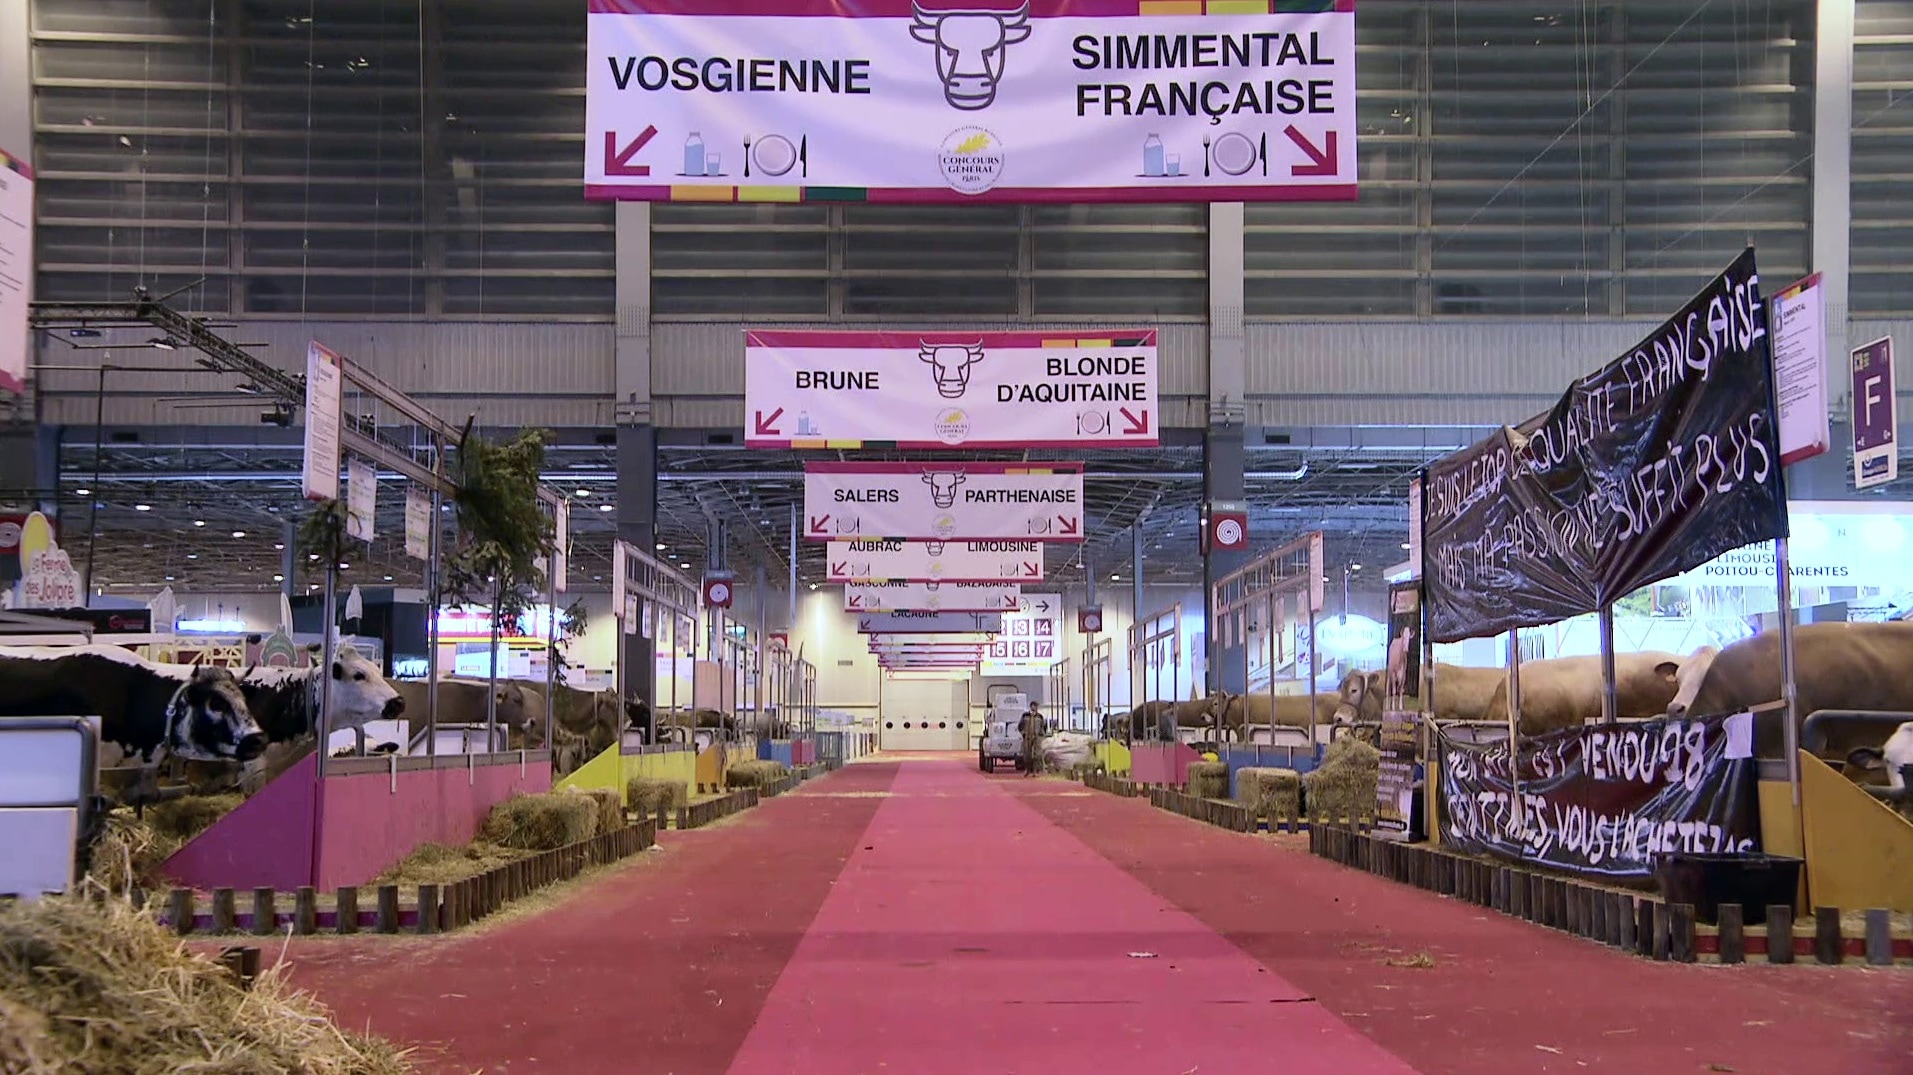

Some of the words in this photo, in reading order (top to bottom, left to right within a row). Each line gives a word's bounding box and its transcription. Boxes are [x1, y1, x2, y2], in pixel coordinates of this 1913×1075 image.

[1071, 32, 1335, 71] SIMMENTAL
[607, 56, 872, 95] VOSGIENNE
[1075, 79, 1336, 124] FRANÇAISE
[942, 157, 1000, 166] CONCOURS
[1046, 356, 1147, 377] BLONDE
[796, 371, 880, 390] BRUNE
[996, 382, 1148, 404] D'AQUITAINE
[1864, 374, 1882, 427] F
[1694, 413, 1770, 508] PLUS
[833, 489, 900, 503] SALERS
[965, 489, 1076, 504] PARTHENAISE
[1437, 471, 1461, 517] SUIS
[849, 541, 902, 552] AUBRAC
[967, 541, 1038, 553] LIMOUSINE
[1717, 554, 1777, 564] LIMOUSI
[1705, 566, 1849, 577] POITOU-CARENTES
[1013, 620, 1029, 635] 13
[1036, 620, 1051, 635] 14
[991, 642, 1006, 657] 15
[1013, 642, 1029, 657] 16
[1036, 642, 1051, 657] 17
[1579, 730, 1660, 784] VENDU
[1554, 801, 1608, 865] VOUS
